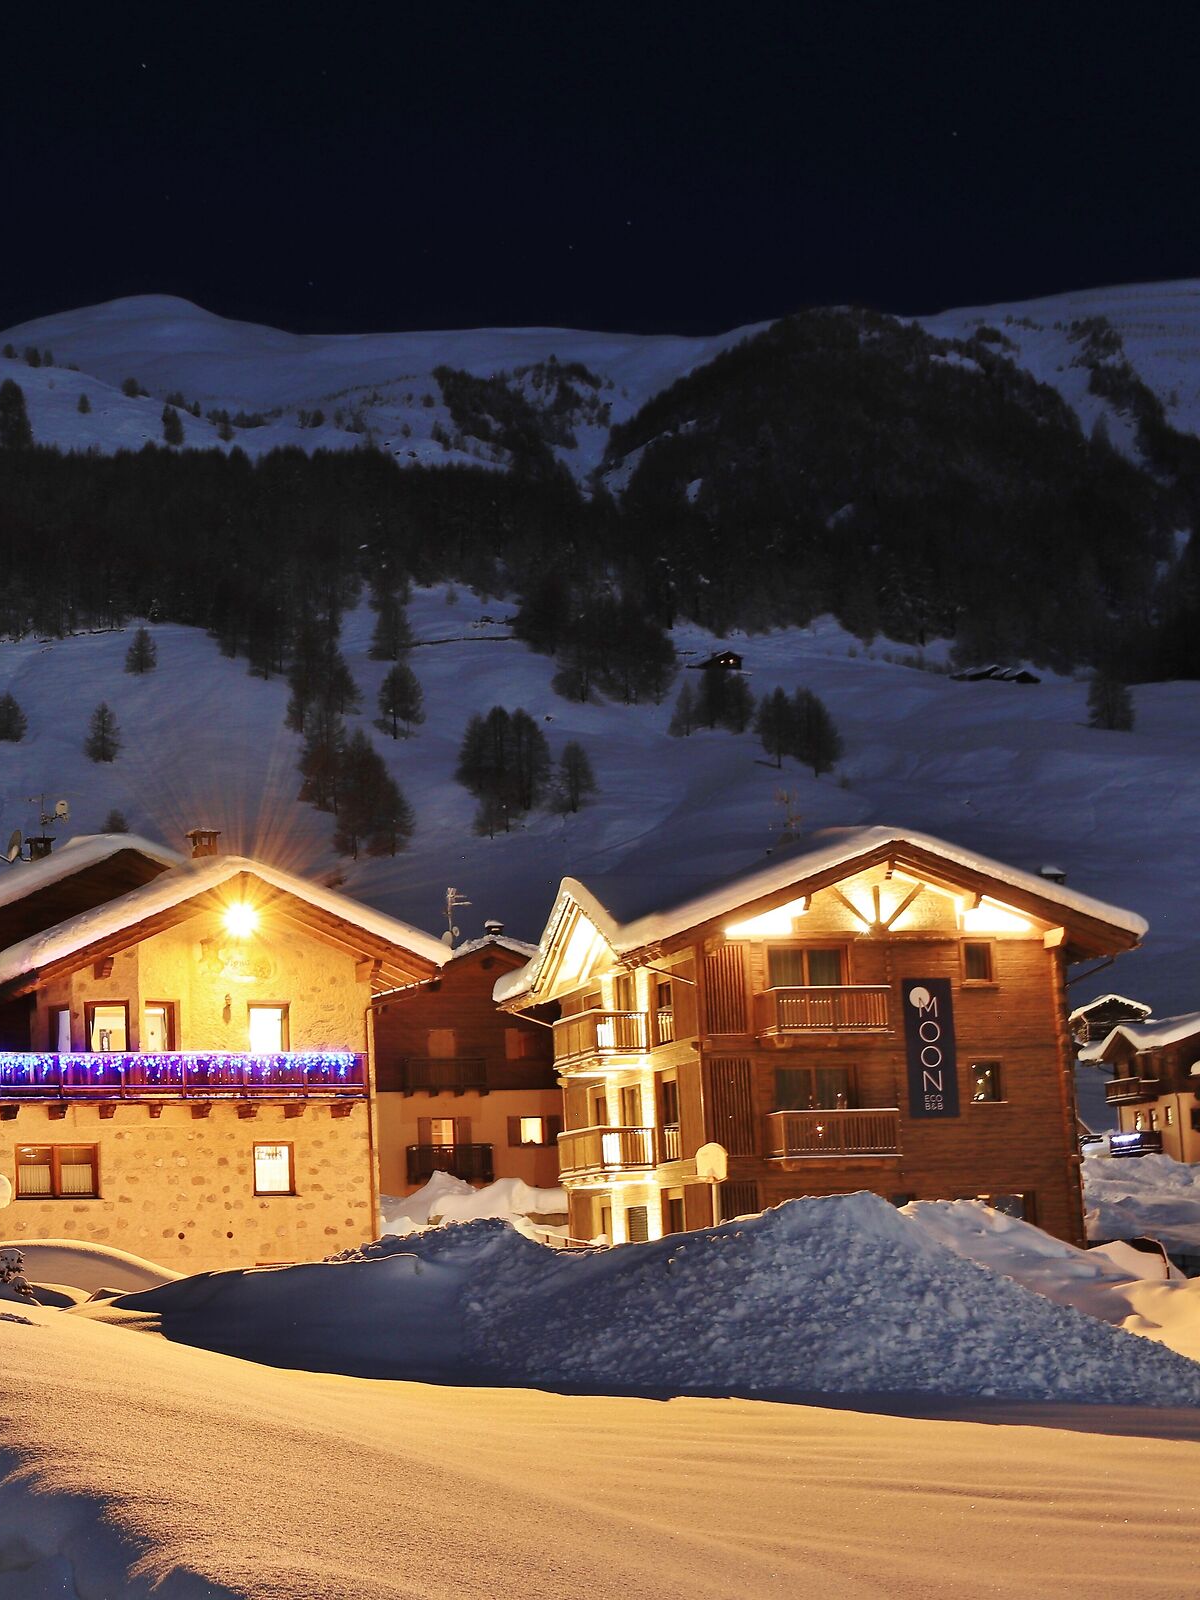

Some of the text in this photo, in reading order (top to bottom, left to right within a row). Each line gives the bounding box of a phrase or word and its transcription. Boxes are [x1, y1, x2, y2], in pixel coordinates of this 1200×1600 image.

[918, 996, 943, 1092] MOON
[924, 1094, 943, 1103] ECO
[925, 1102, 944, 1111] B&B
